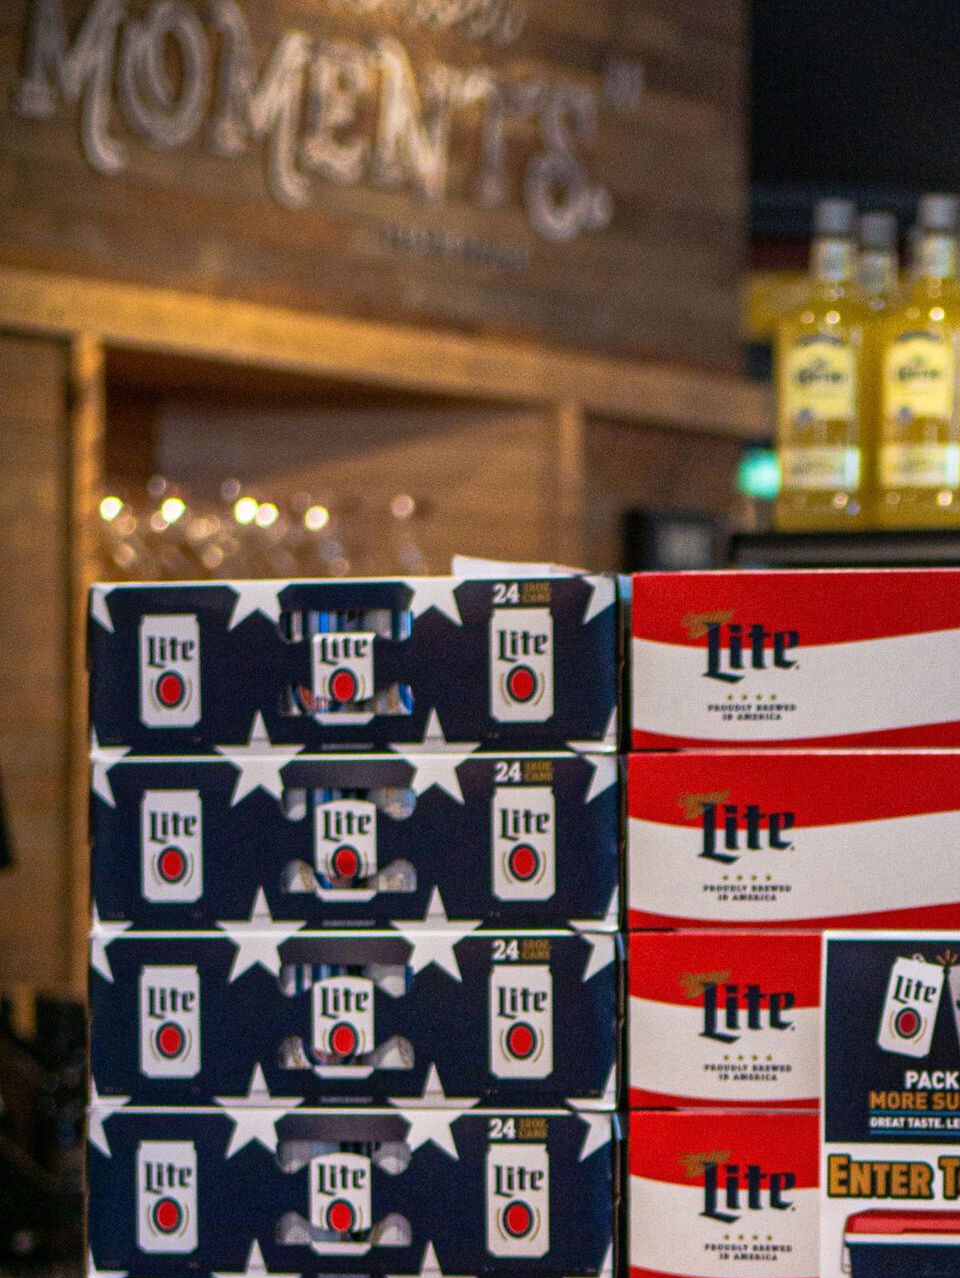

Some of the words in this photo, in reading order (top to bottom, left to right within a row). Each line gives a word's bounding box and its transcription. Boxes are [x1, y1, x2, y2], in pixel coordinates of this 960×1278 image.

[492, 583, 521, 604] 24
[146, 635, 196, 668] Lite
[319, 633, 369, 665] Lite
[498, 630, 548, 661] Lite
[703, 619, 799, 685] Lite
[494, 762, 522, 782] 24
[149, 811, 198, 842] Lite
[321, 811, 372, 841] Lite
[499, 808, 550, 840] Lite
[697, 800, 794, 866] Lite
[491, 940, 519, 960] 24
[146, 986, 196, 1018] Lite
[319, 986, 369, 1017] Lite
[497, 985, 547, 1017] Lite
[892, 974, 937, 1005] Lite
[698, 979, 794, 1045] Lite
[905, 1070, 960, 1090] PACK
[869, 1091, 927, 1110] MORE
[488, 1119, 517, 1139] 24
[869, 1117, 904, 1129] GREAT
[906, 1117, 944, 1130] TASTE.
[144, 1162, 193, 1193] Lite
[316, 1164, 367, 1194] Lite
[494, 1165, 544, 1196] Lite
[699, 1159, 795, 1225] Lite
[827, 1153, 934, 1200] ENTER
